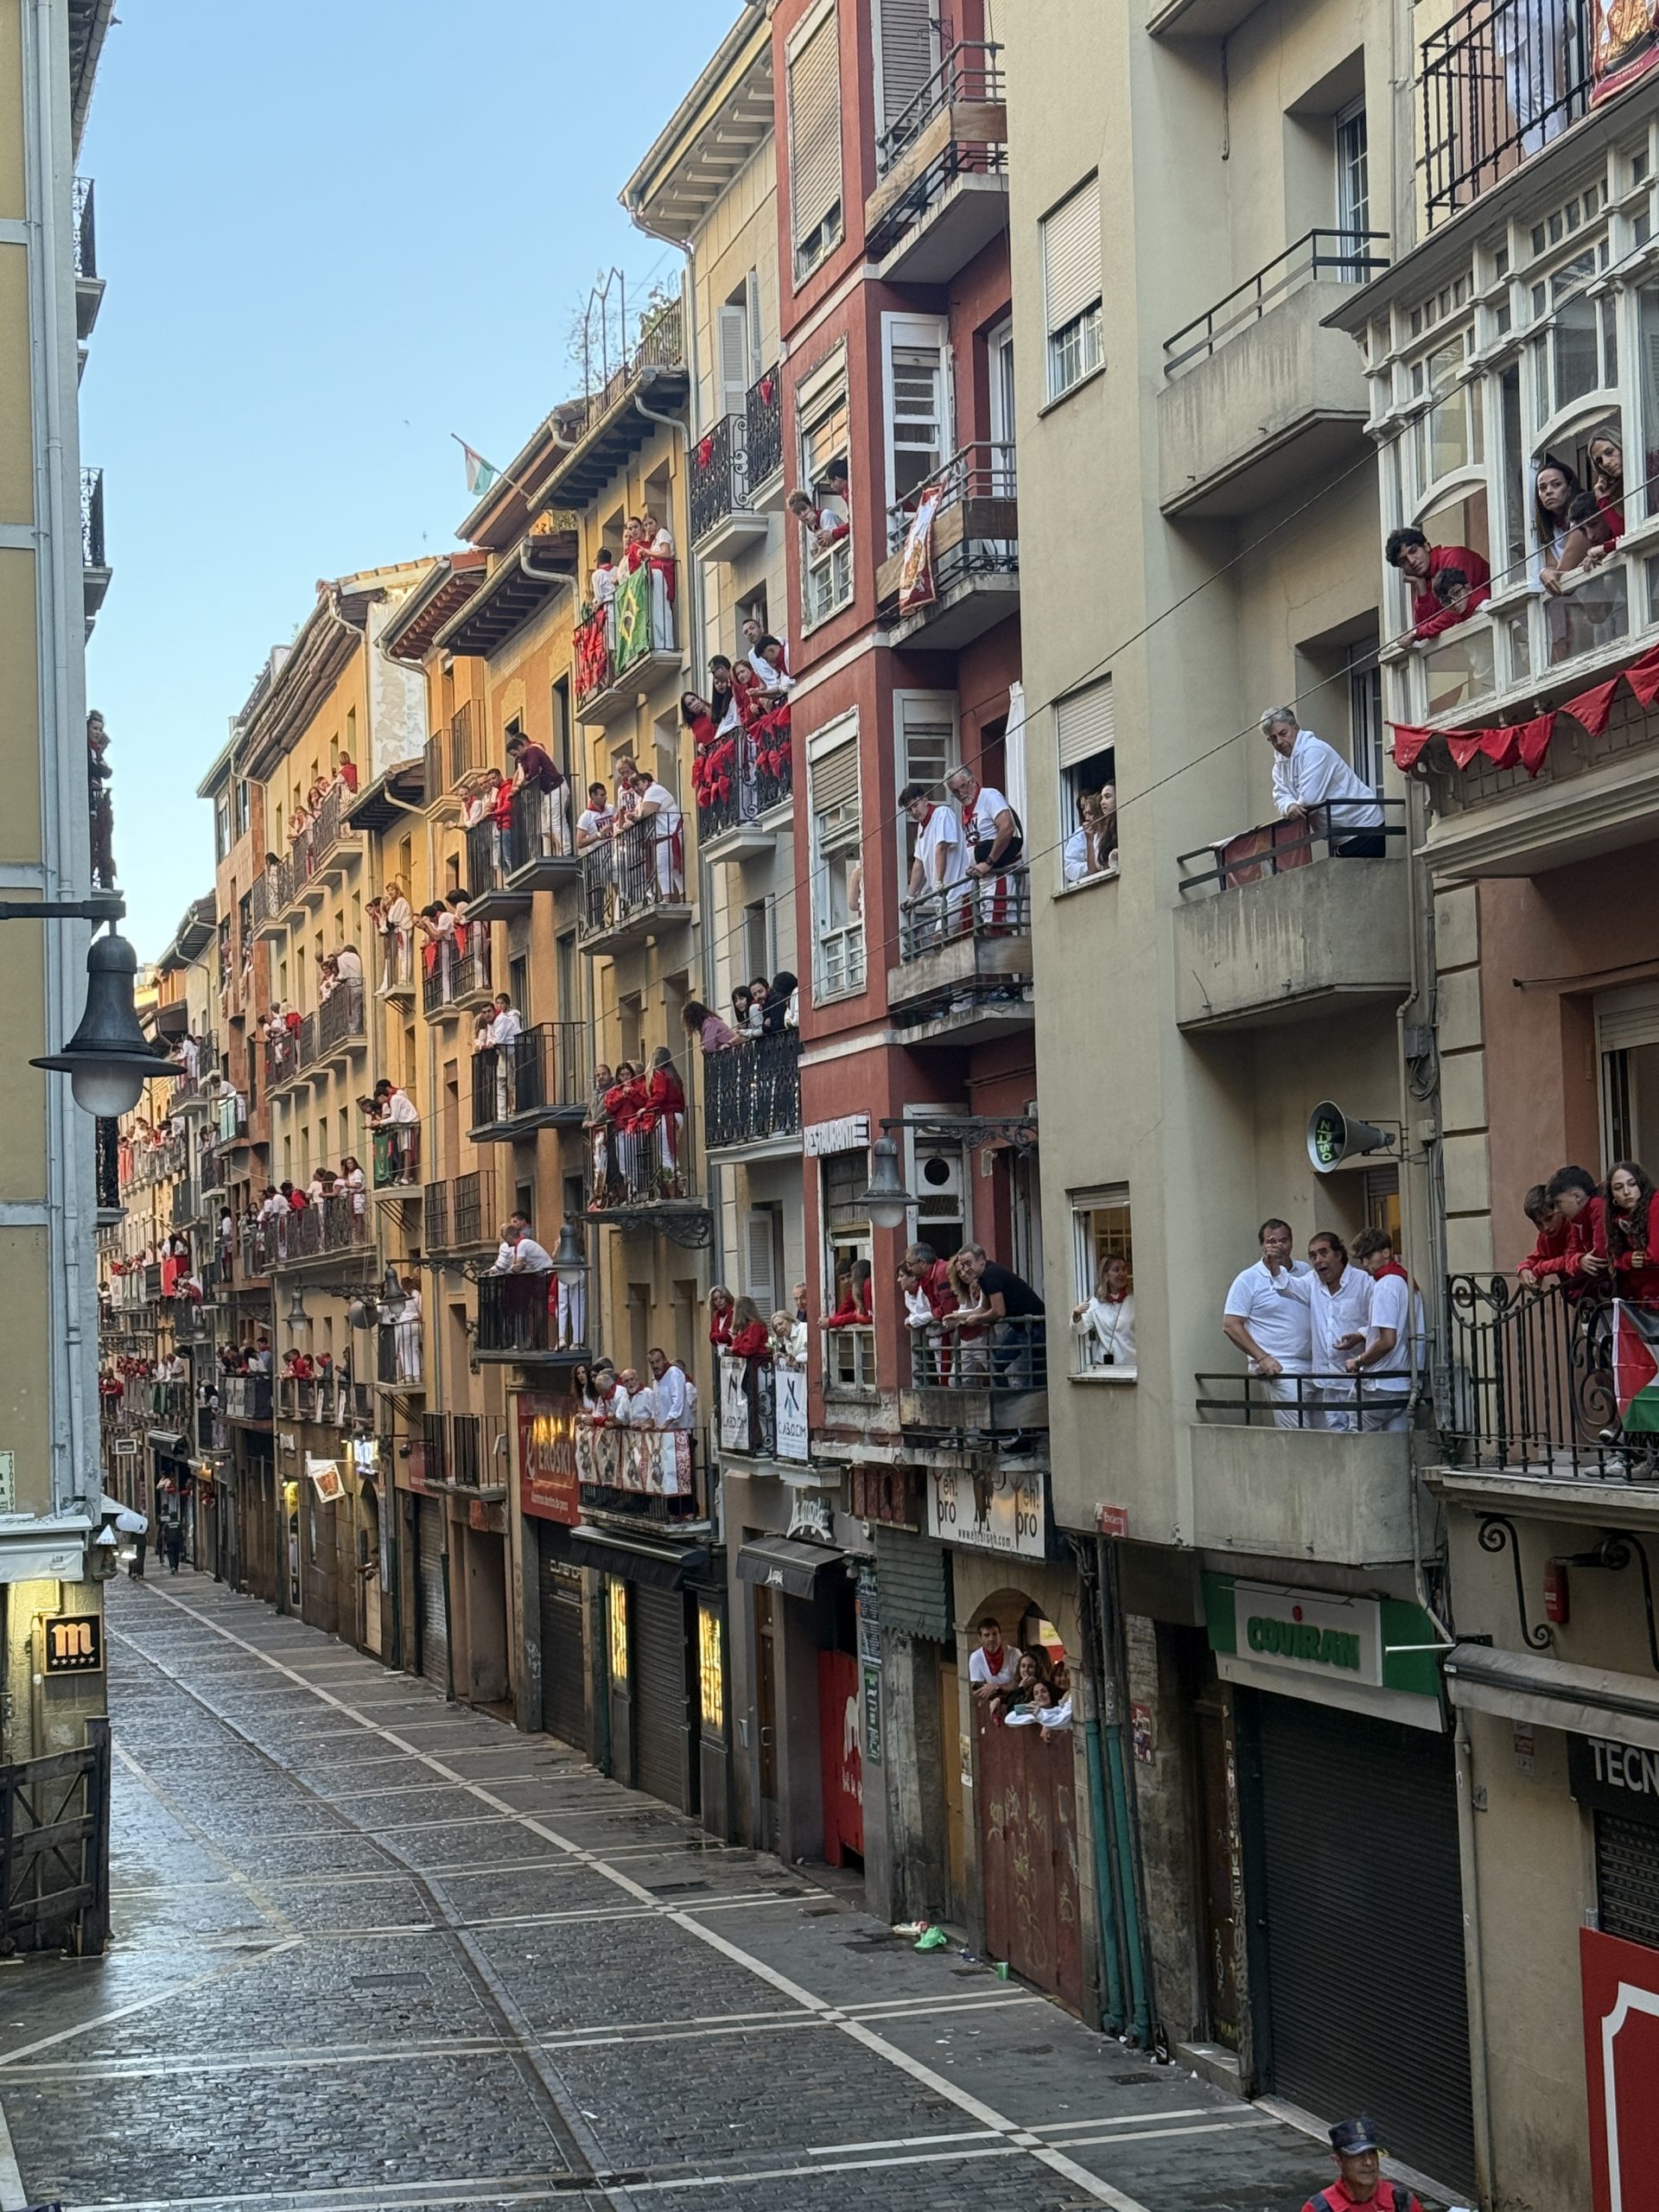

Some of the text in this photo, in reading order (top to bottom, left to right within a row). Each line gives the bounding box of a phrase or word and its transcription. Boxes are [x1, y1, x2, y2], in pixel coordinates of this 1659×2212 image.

[1317, 1119, 1332, 1161] ostiz
[538, 1442, 571, 1476] EROSKI
[50, 1622, 96, 1657] m
